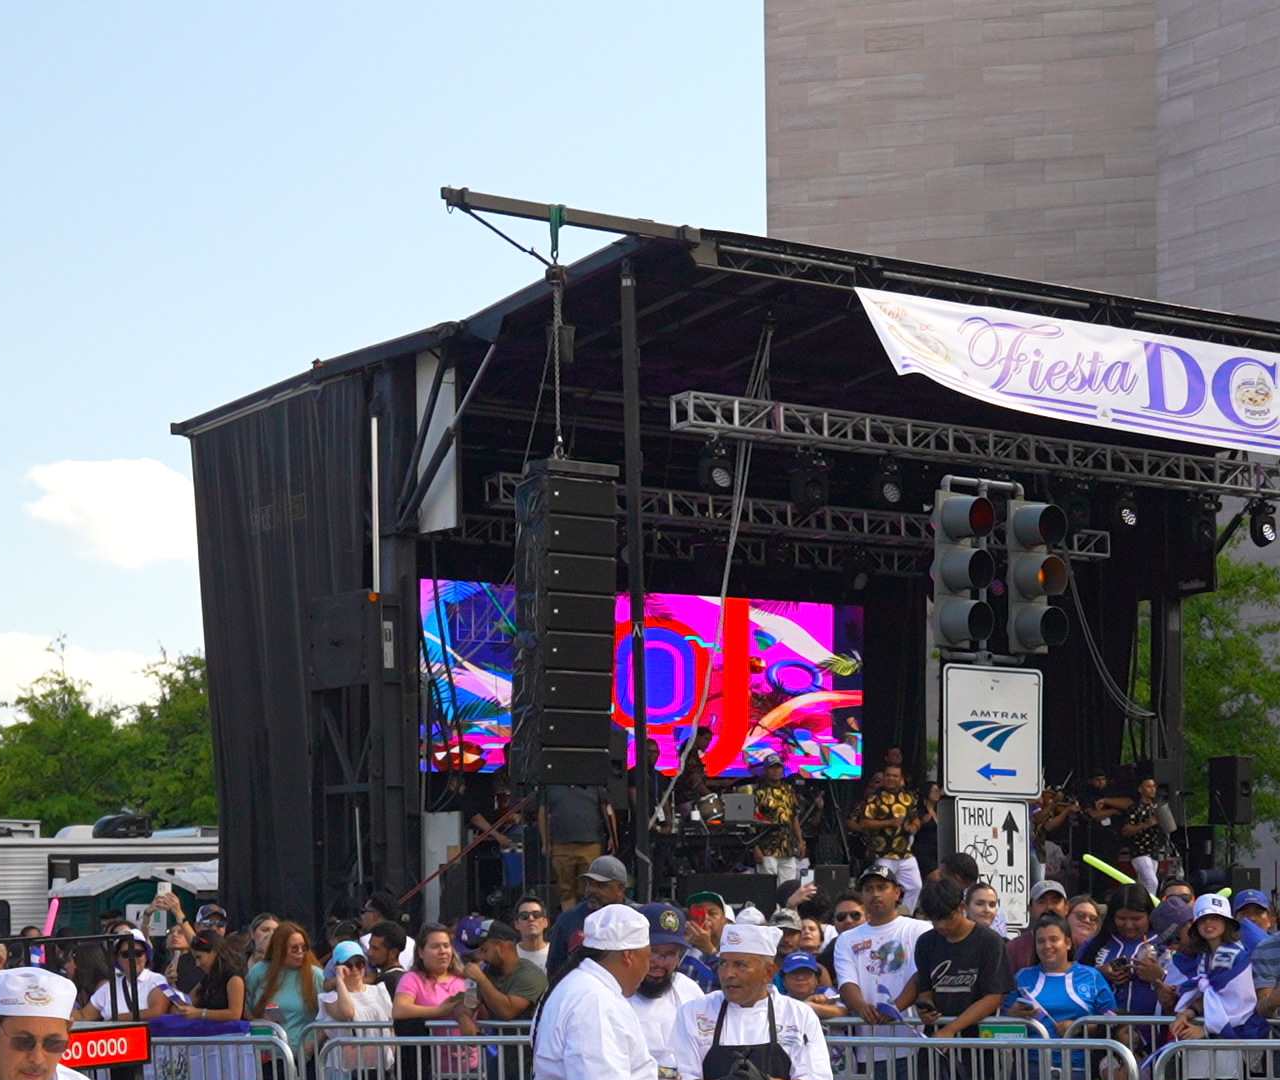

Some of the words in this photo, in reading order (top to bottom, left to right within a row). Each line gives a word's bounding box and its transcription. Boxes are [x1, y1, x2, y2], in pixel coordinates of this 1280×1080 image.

[957, 316, 1138, 395] Fiesta
[1133, 338, 1280, 433] DC
[969, 709, 1028, 720] AMTRAK
[961, 806, 994, 827] THRU
[998, 874, 1025, 894] THIS
[86, 1037, 128, 1058] 0000
